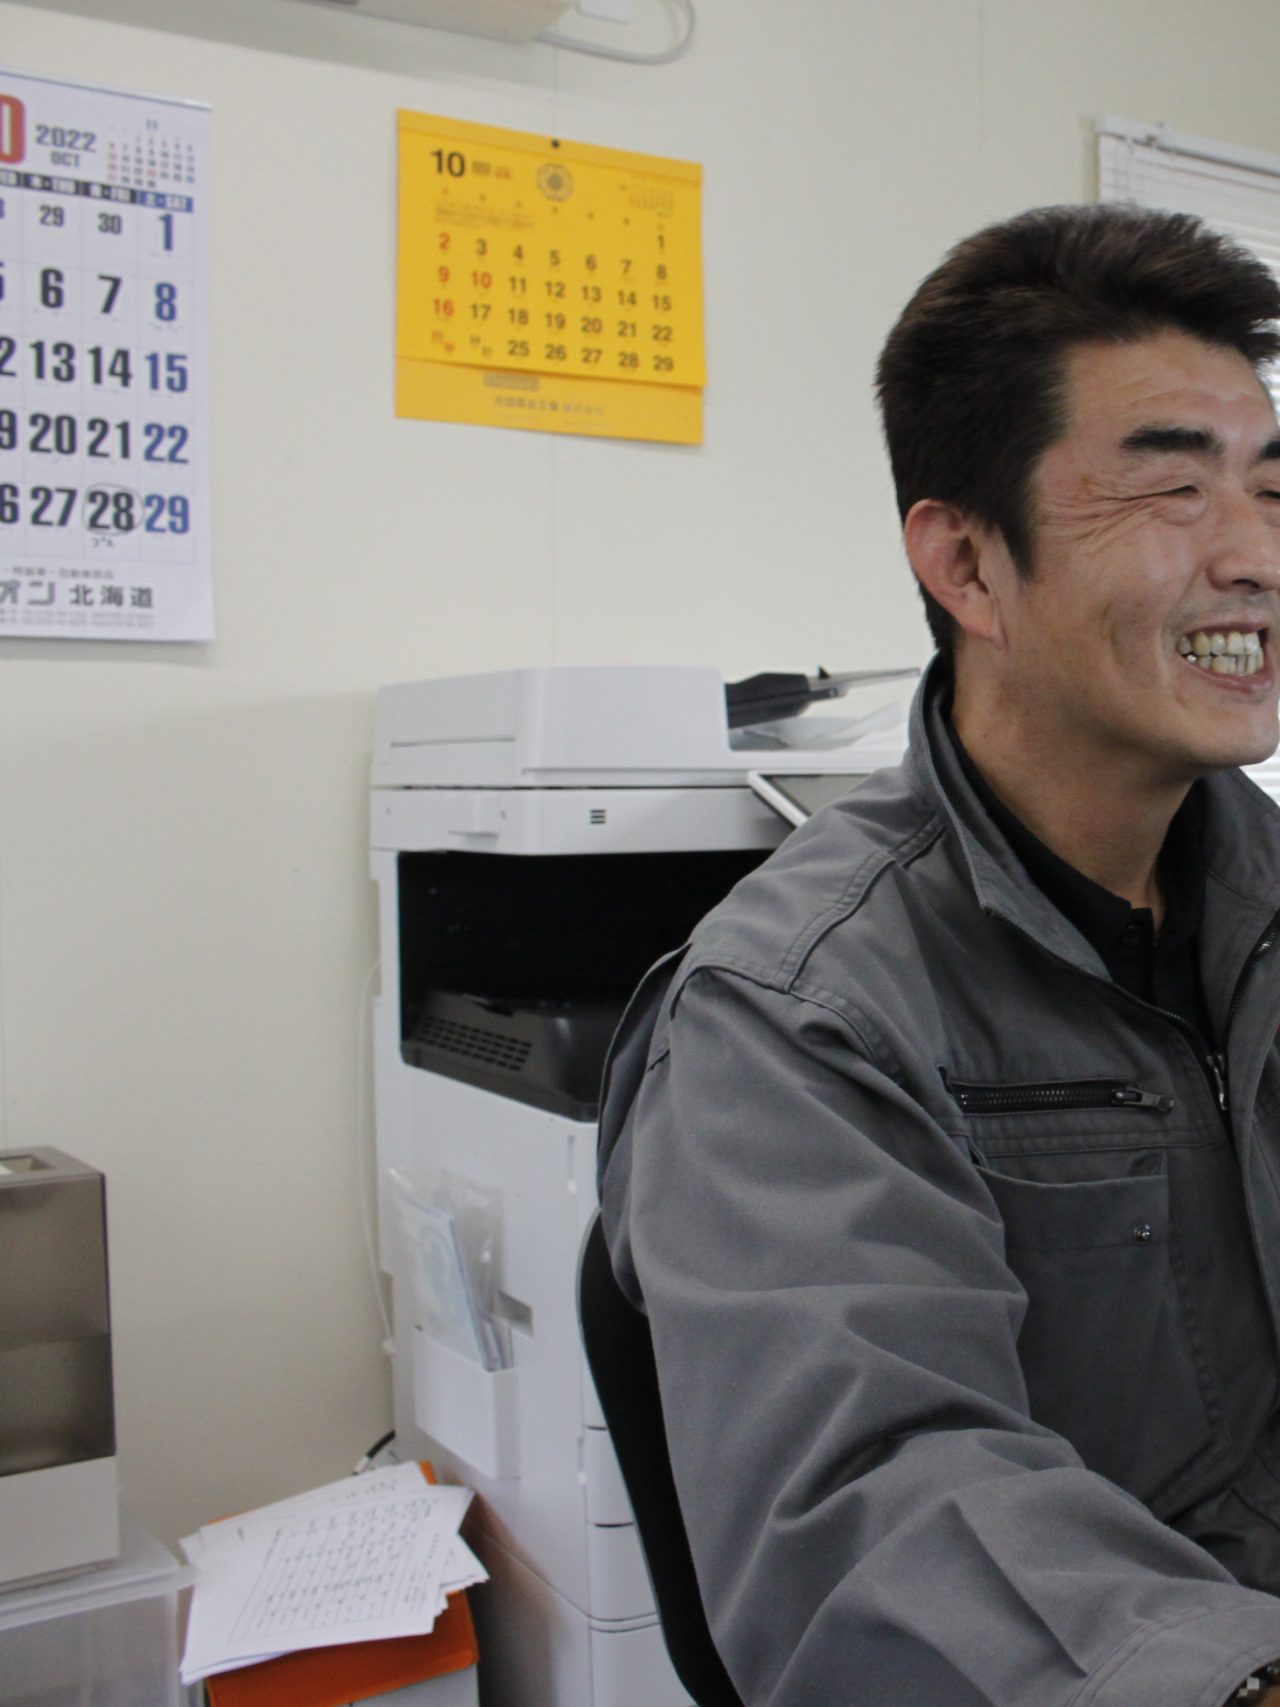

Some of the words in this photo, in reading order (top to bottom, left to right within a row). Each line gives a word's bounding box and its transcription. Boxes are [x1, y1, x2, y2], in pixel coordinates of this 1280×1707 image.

[0, 94, 25, 164] 0
[36, 124, 96, 152] 2022
[51, 151, 80, 167] OCT
[431, 149, 466, 178] 10
[40, 205, 64, 227] 29
[98, 213, 122, 234] 30
[159, 214, 172, 251] 1
[438, 231, 451, 251] 2
[475, 237, 488, 257] 3
[512, 244, 524, 261] 4
[549, 249, 561, 267] 5
[585, 254, 597, 272] 6
[621, 258, 633, 275] 7
[656, 264, 667, 281] 8
[41, 268, 63, 308] 6
[99, 275, 121, 314] 7
[155, 283, 176, 321] 8
[437, 265, 451, 284] 9
[471, 270, 493, 291] 10
[545, 281, 566, 299] 12
[581, 285, 602, 304] 13
[617, 289, 637, 307] 14
[652, 294, 673, 313] 15
[432, 297, 455, 318] 16
[470, 303, 492, 321] 17
[508, 307, 529, 326] 18
[545, 312, 567, 331] 19
[580, 315, 603, 335] 20
[617, 320, 637, 338] 21
[652, 324, 673, 343] 22
[0, 336, 16, 376] 2
[30, 341, 75, 382] 13
[88, 347, 132, 387] 14
[146, 353, 187, 392] 15
[507, 339, 531, 358] 25
[544, 343, 567, 362] 26
[581, 346, 603, 365] 27
[618, 350, 640, 369] 28
[652, 354, 675, 372] 29
[0, 410, 17, 450] 9
[30, 413, 76, 455] 20
[88, 418, 129, 459] 21
[144, 423, 188, 464] 22
[0, 484, 18, 524] 6
[30, 486, 77, 526] 27
[88, 491, 134, 532] 28
[143, 494, 189, 534] 29
[70, 584, 152, 608] 北海道
